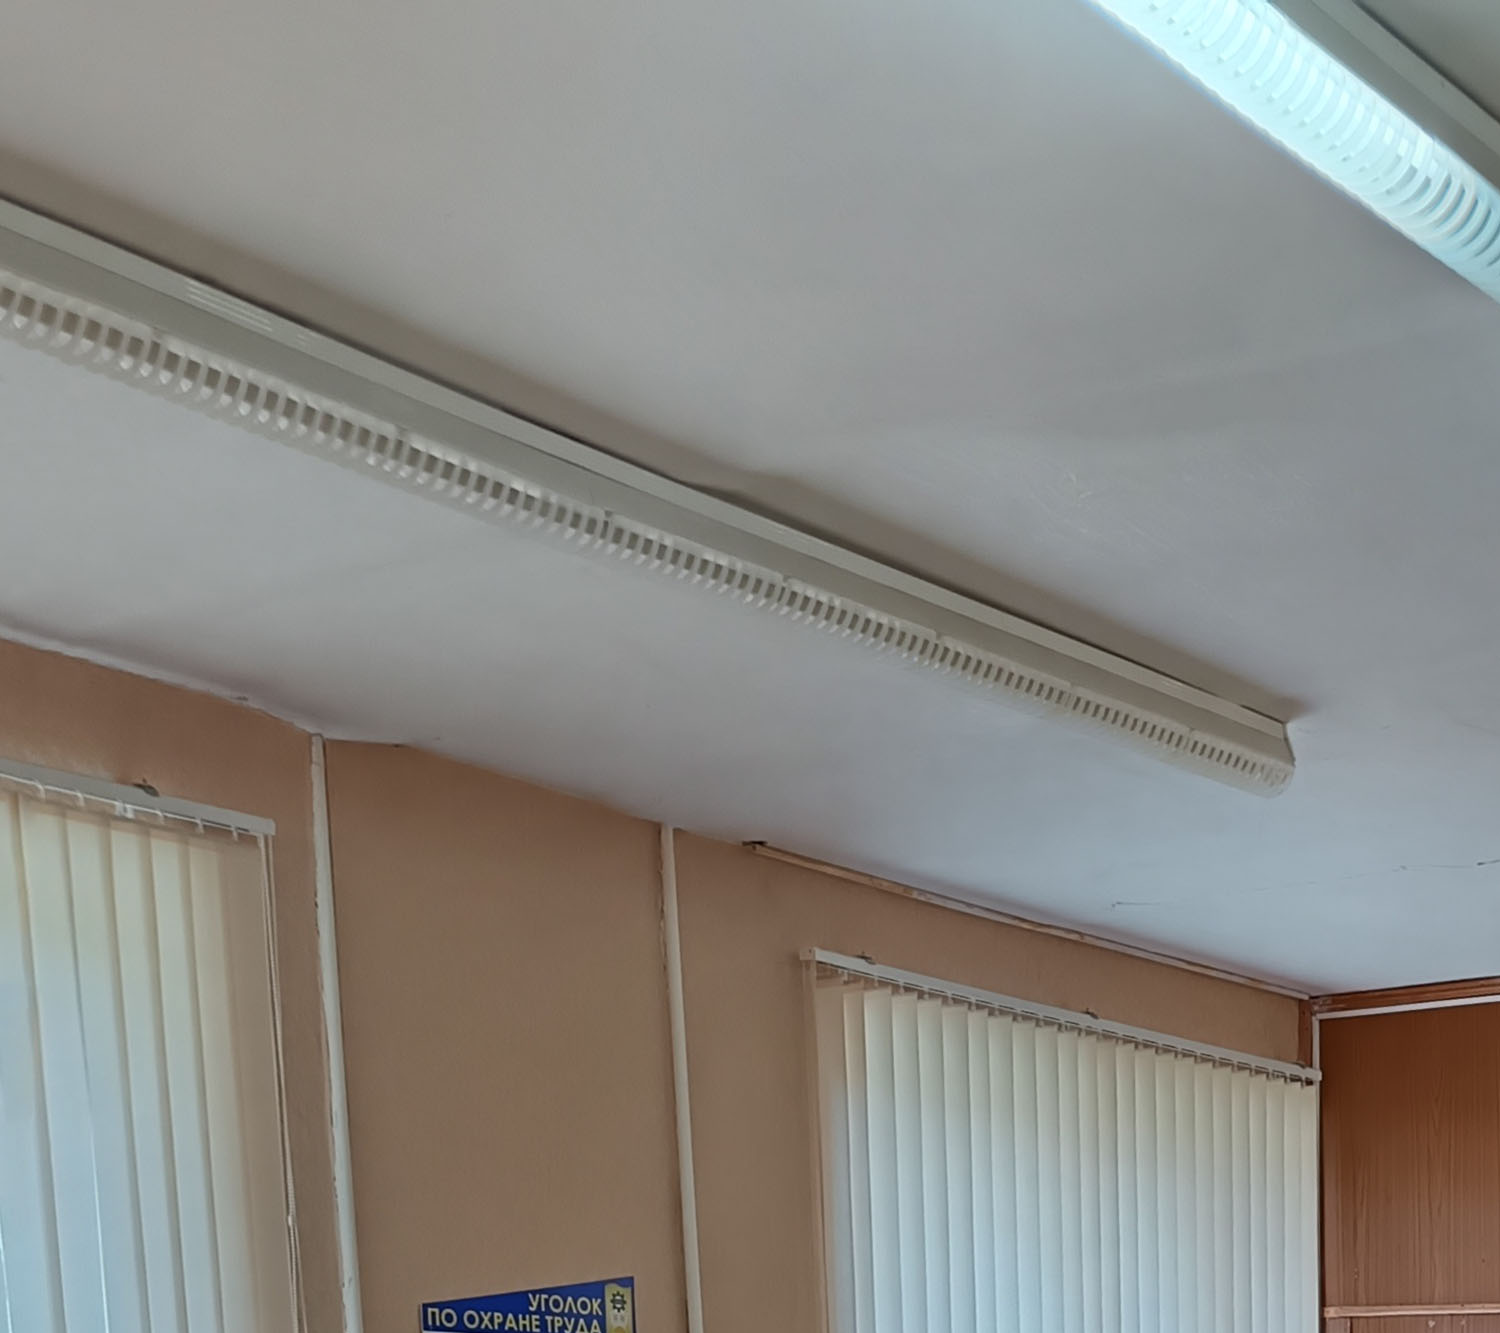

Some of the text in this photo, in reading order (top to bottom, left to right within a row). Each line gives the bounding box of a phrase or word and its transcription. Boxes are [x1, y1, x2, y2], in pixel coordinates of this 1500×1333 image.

[528, 1293, 603, 1316] УГОЛОК
[427, 1307, 457, 1328] ПО
[463, 1310, 541, 1333] ОХРАНЕ
